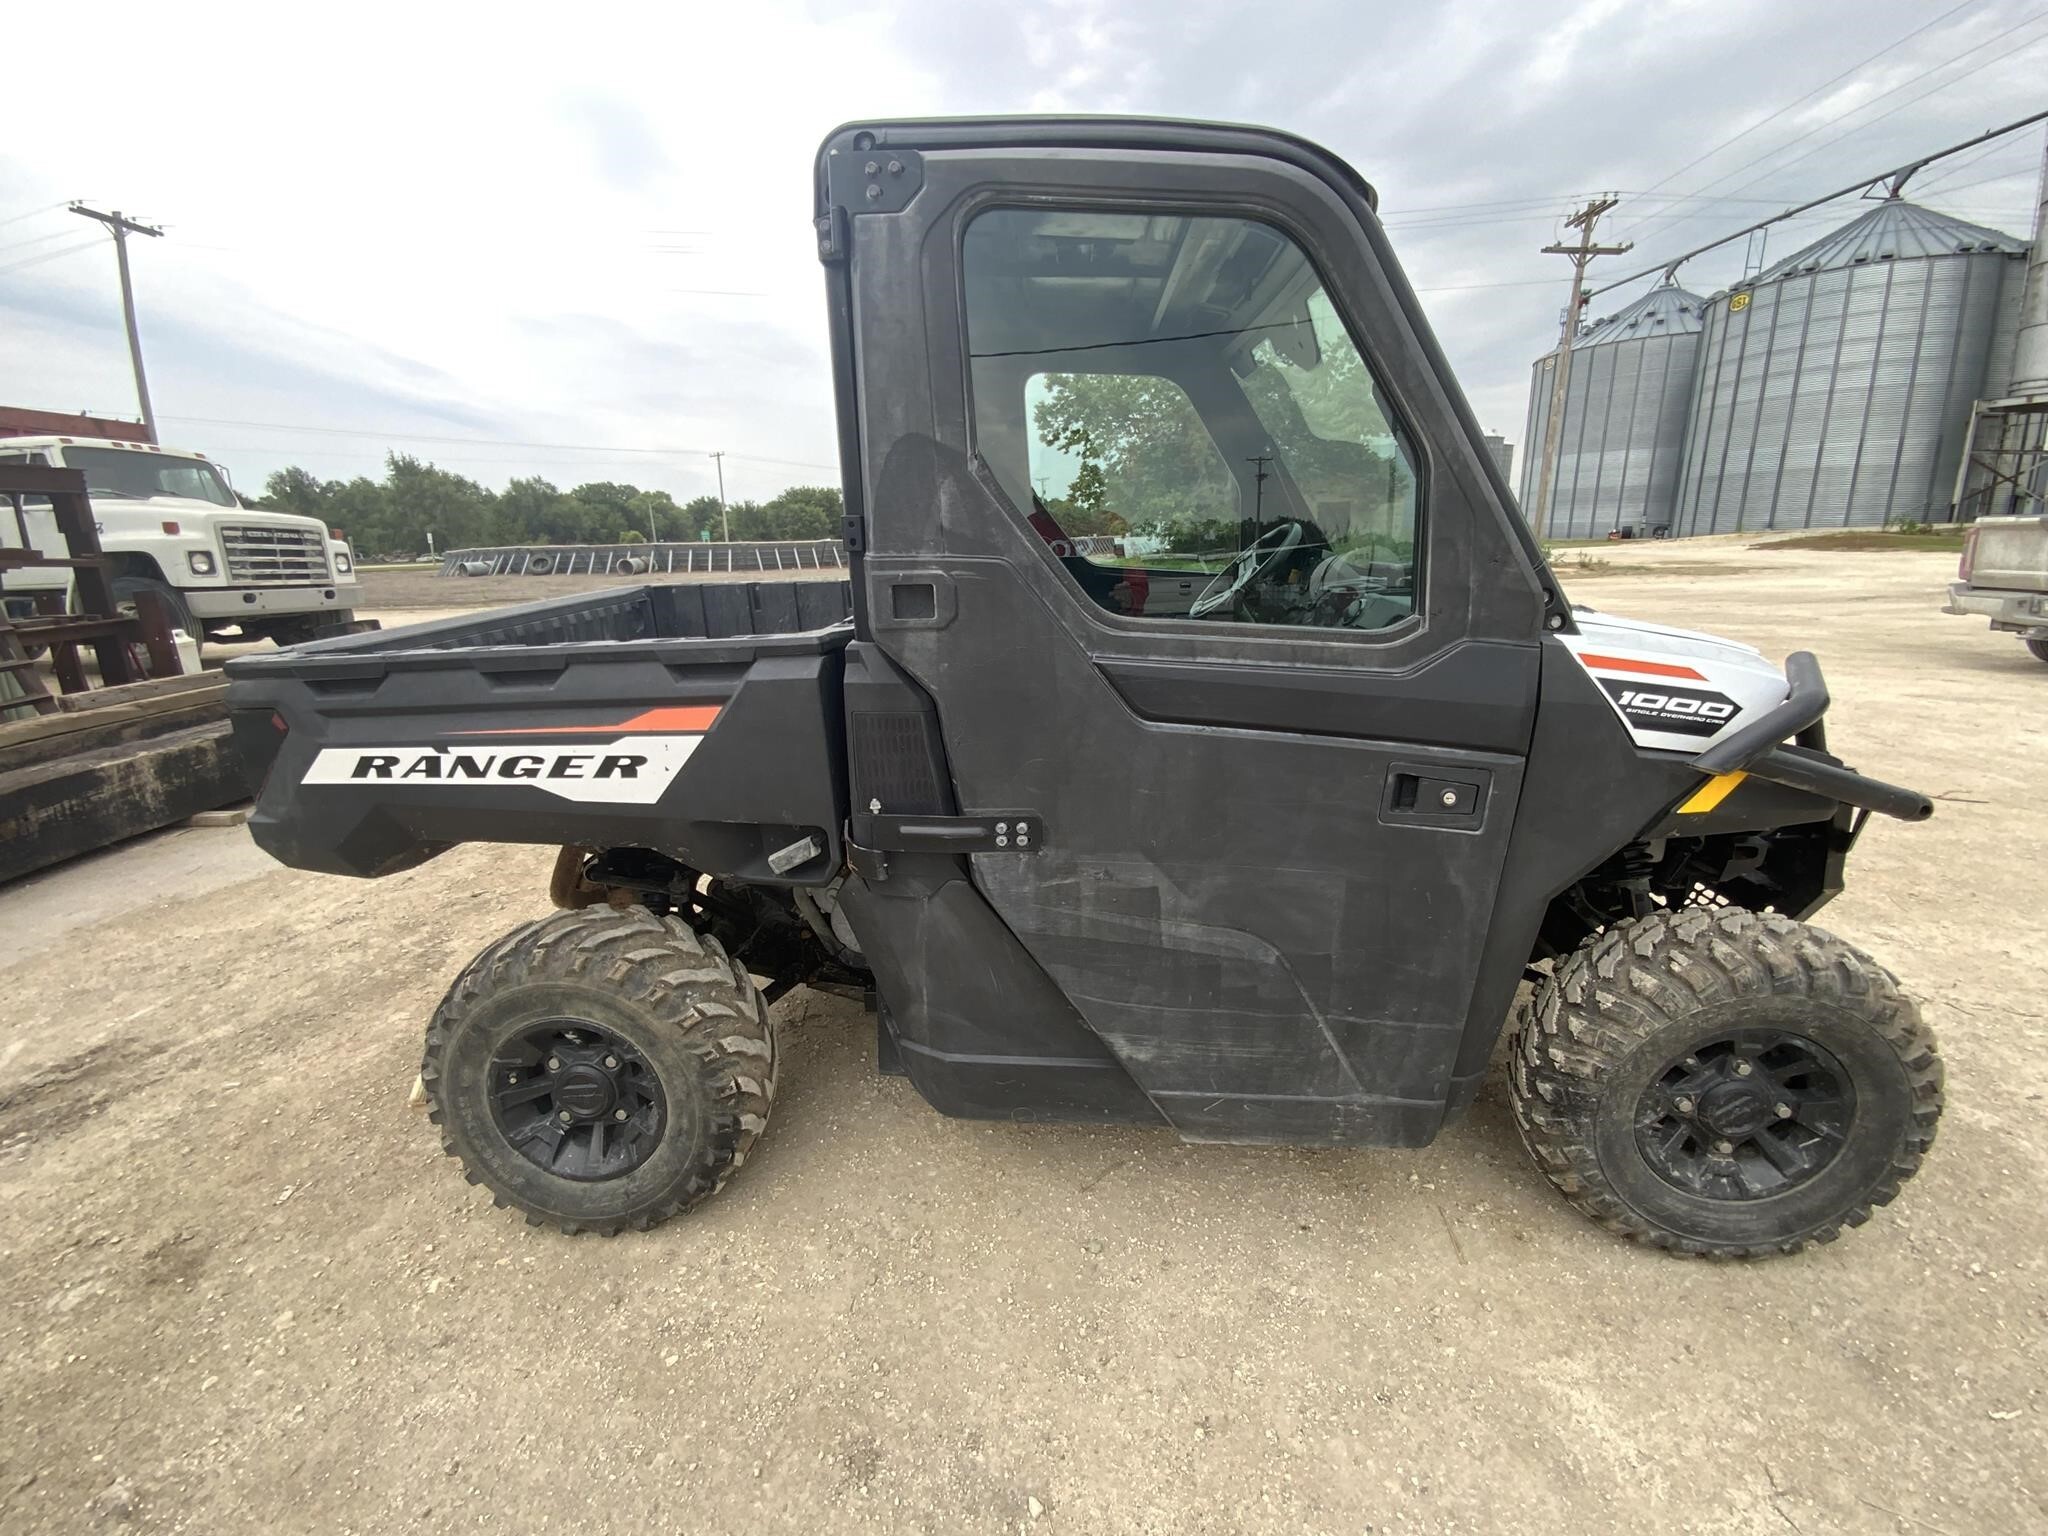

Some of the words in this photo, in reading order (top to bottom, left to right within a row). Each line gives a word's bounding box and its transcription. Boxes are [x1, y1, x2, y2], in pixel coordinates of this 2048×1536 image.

[1618, 690, 1734, 718] 1000
[1625, 707, 1659, 717] SINGLE
[1660, 712, 1706, 722] OVERHEAD
[350, 755, 649, 779] RANGER
